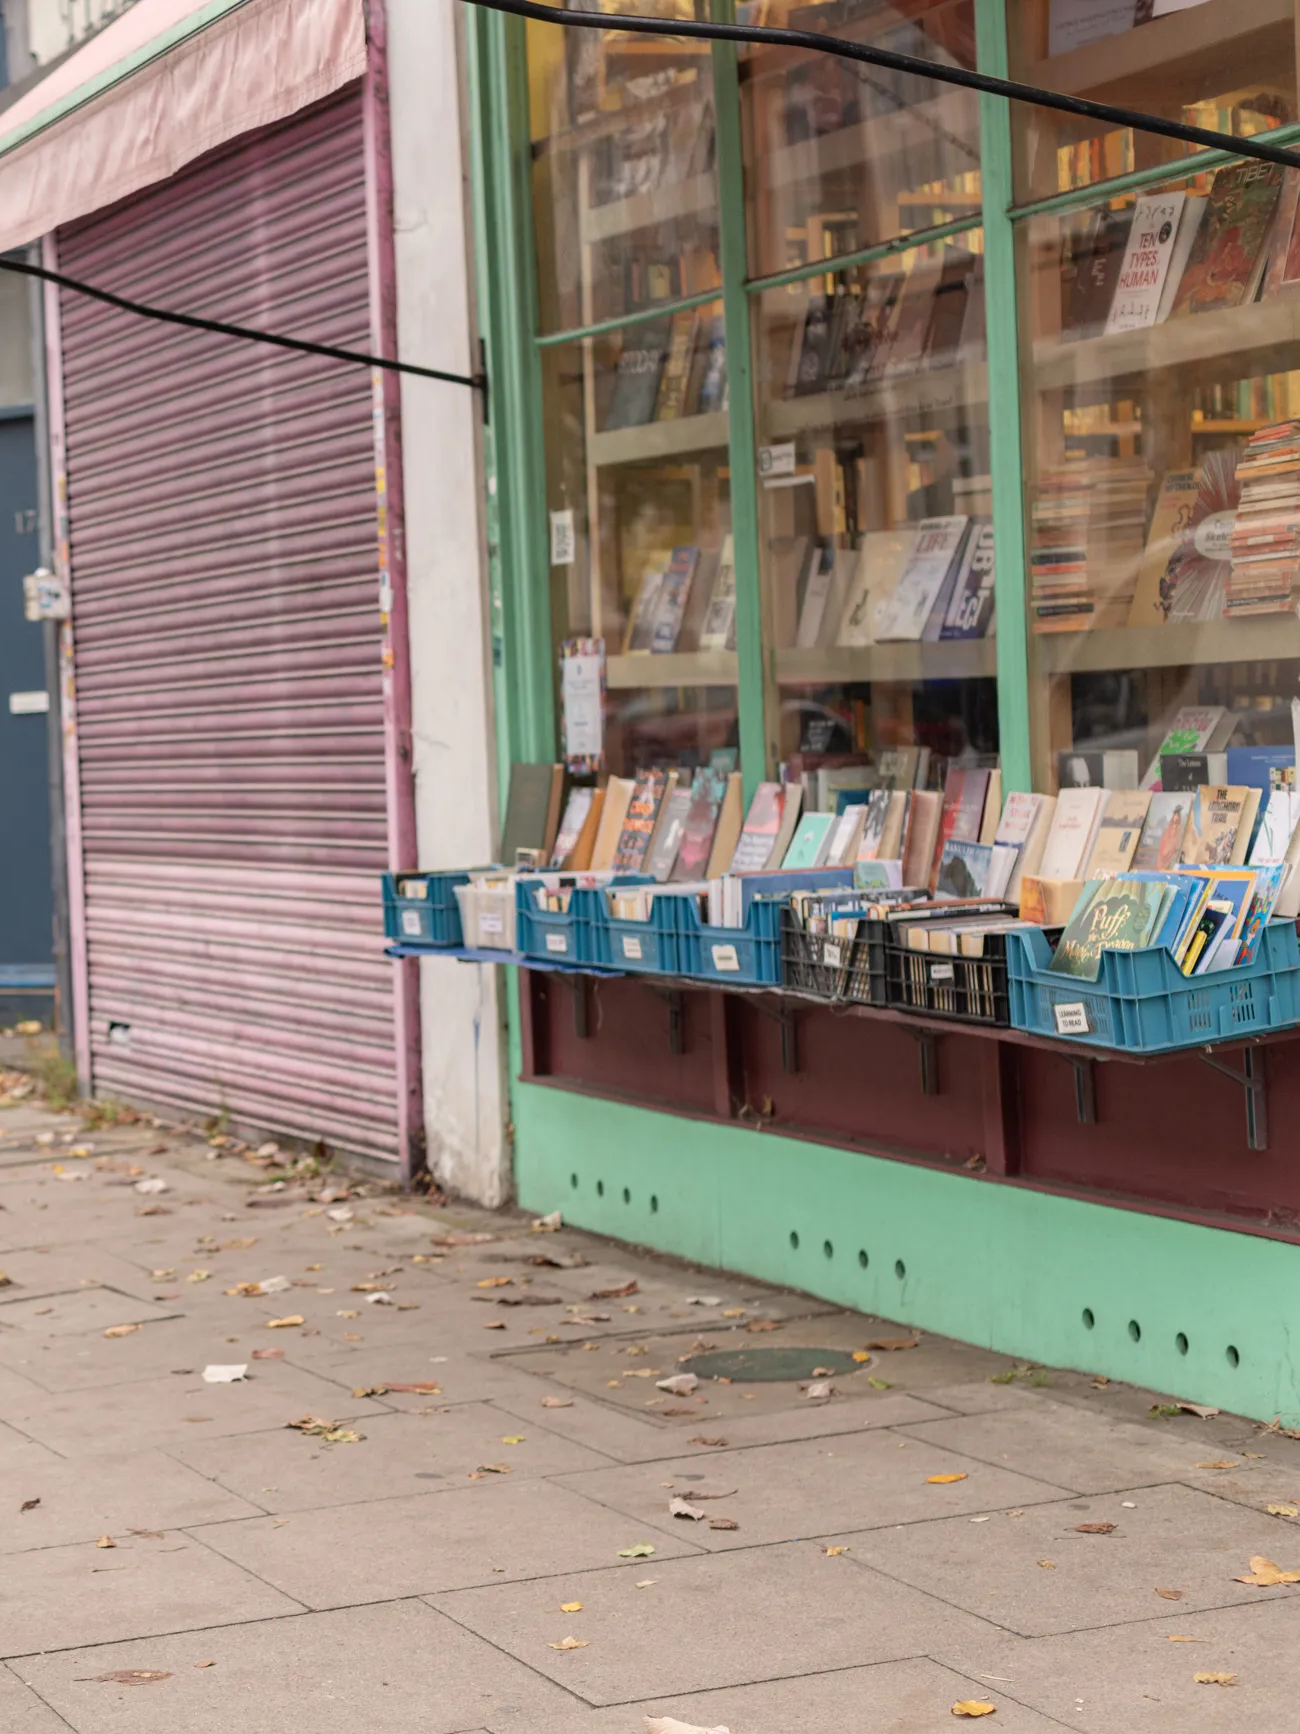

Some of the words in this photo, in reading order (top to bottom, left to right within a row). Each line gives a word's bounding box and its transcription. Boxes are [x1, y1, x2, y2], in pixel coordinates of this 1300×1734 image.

[1236, 162, 1276, 184] TIBET
[1140, 232, 1159, 248] TEN
[1130, 251, 1159, 268] TYPES
[1119, 270, 1159, 288] HUMAN
[1217, 788, 1228, 799] THE
[1090, 904, 1132, 940] Puff
[1069, 1018, 1082, 1027] READ
